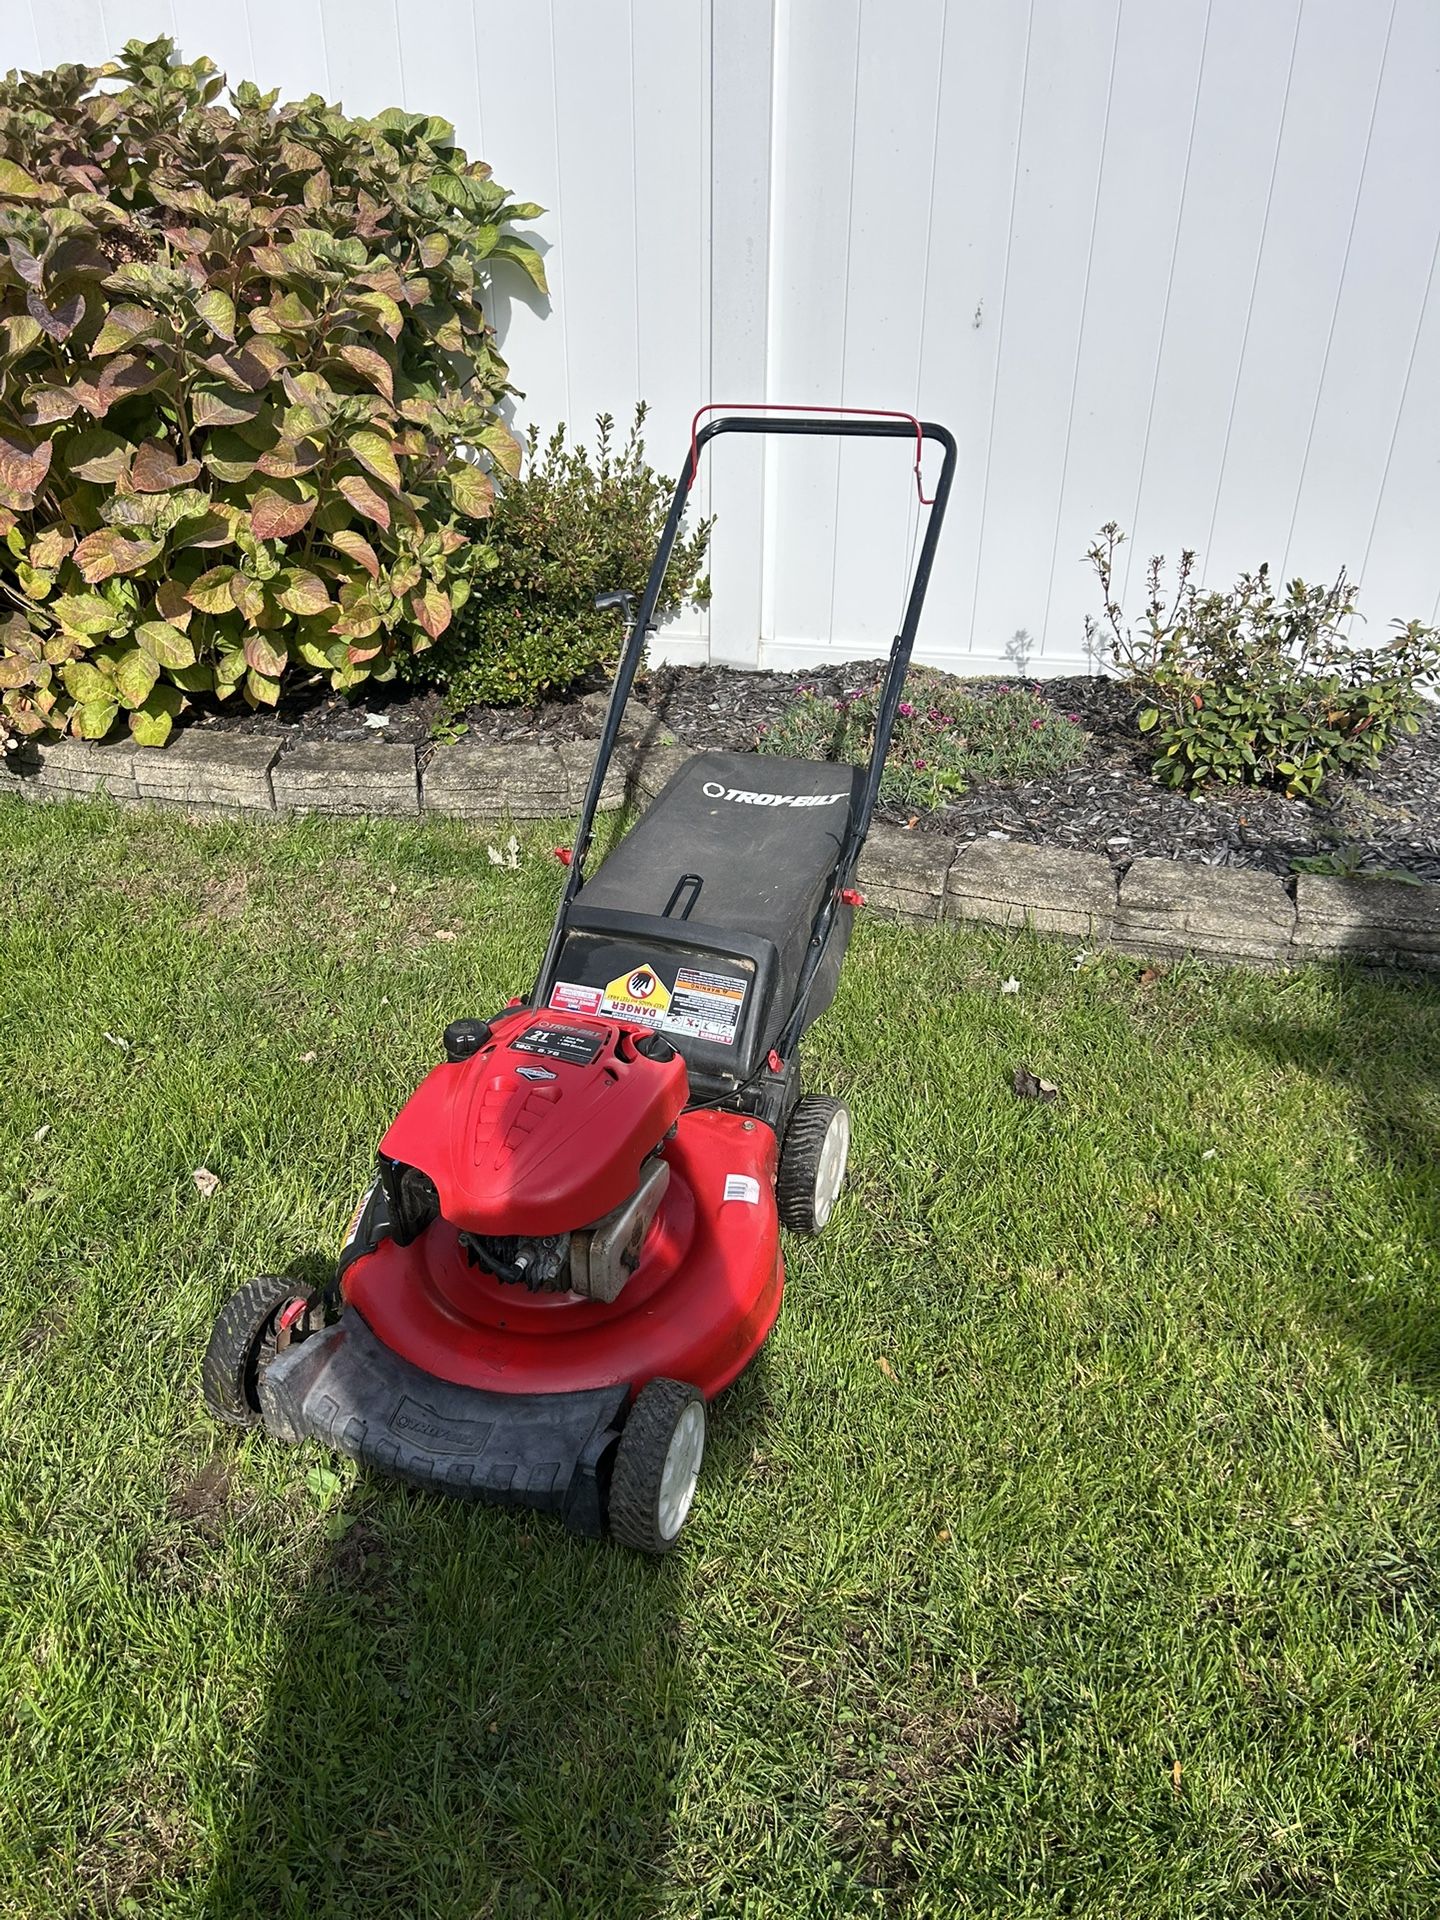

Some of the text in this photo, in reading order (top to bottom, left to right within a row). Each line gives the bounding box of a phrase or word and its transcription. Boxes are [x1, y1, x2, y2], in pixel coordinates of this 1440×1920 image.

[724, 788, 850, 807] TROY-BILT
[691, 984, 720, 994] WARNING
[612, 1001, 657, 1017] DANGER
[529, 1030, 550, 1041] 21
[549, 1023, 603, 1037] TROY-BILT
